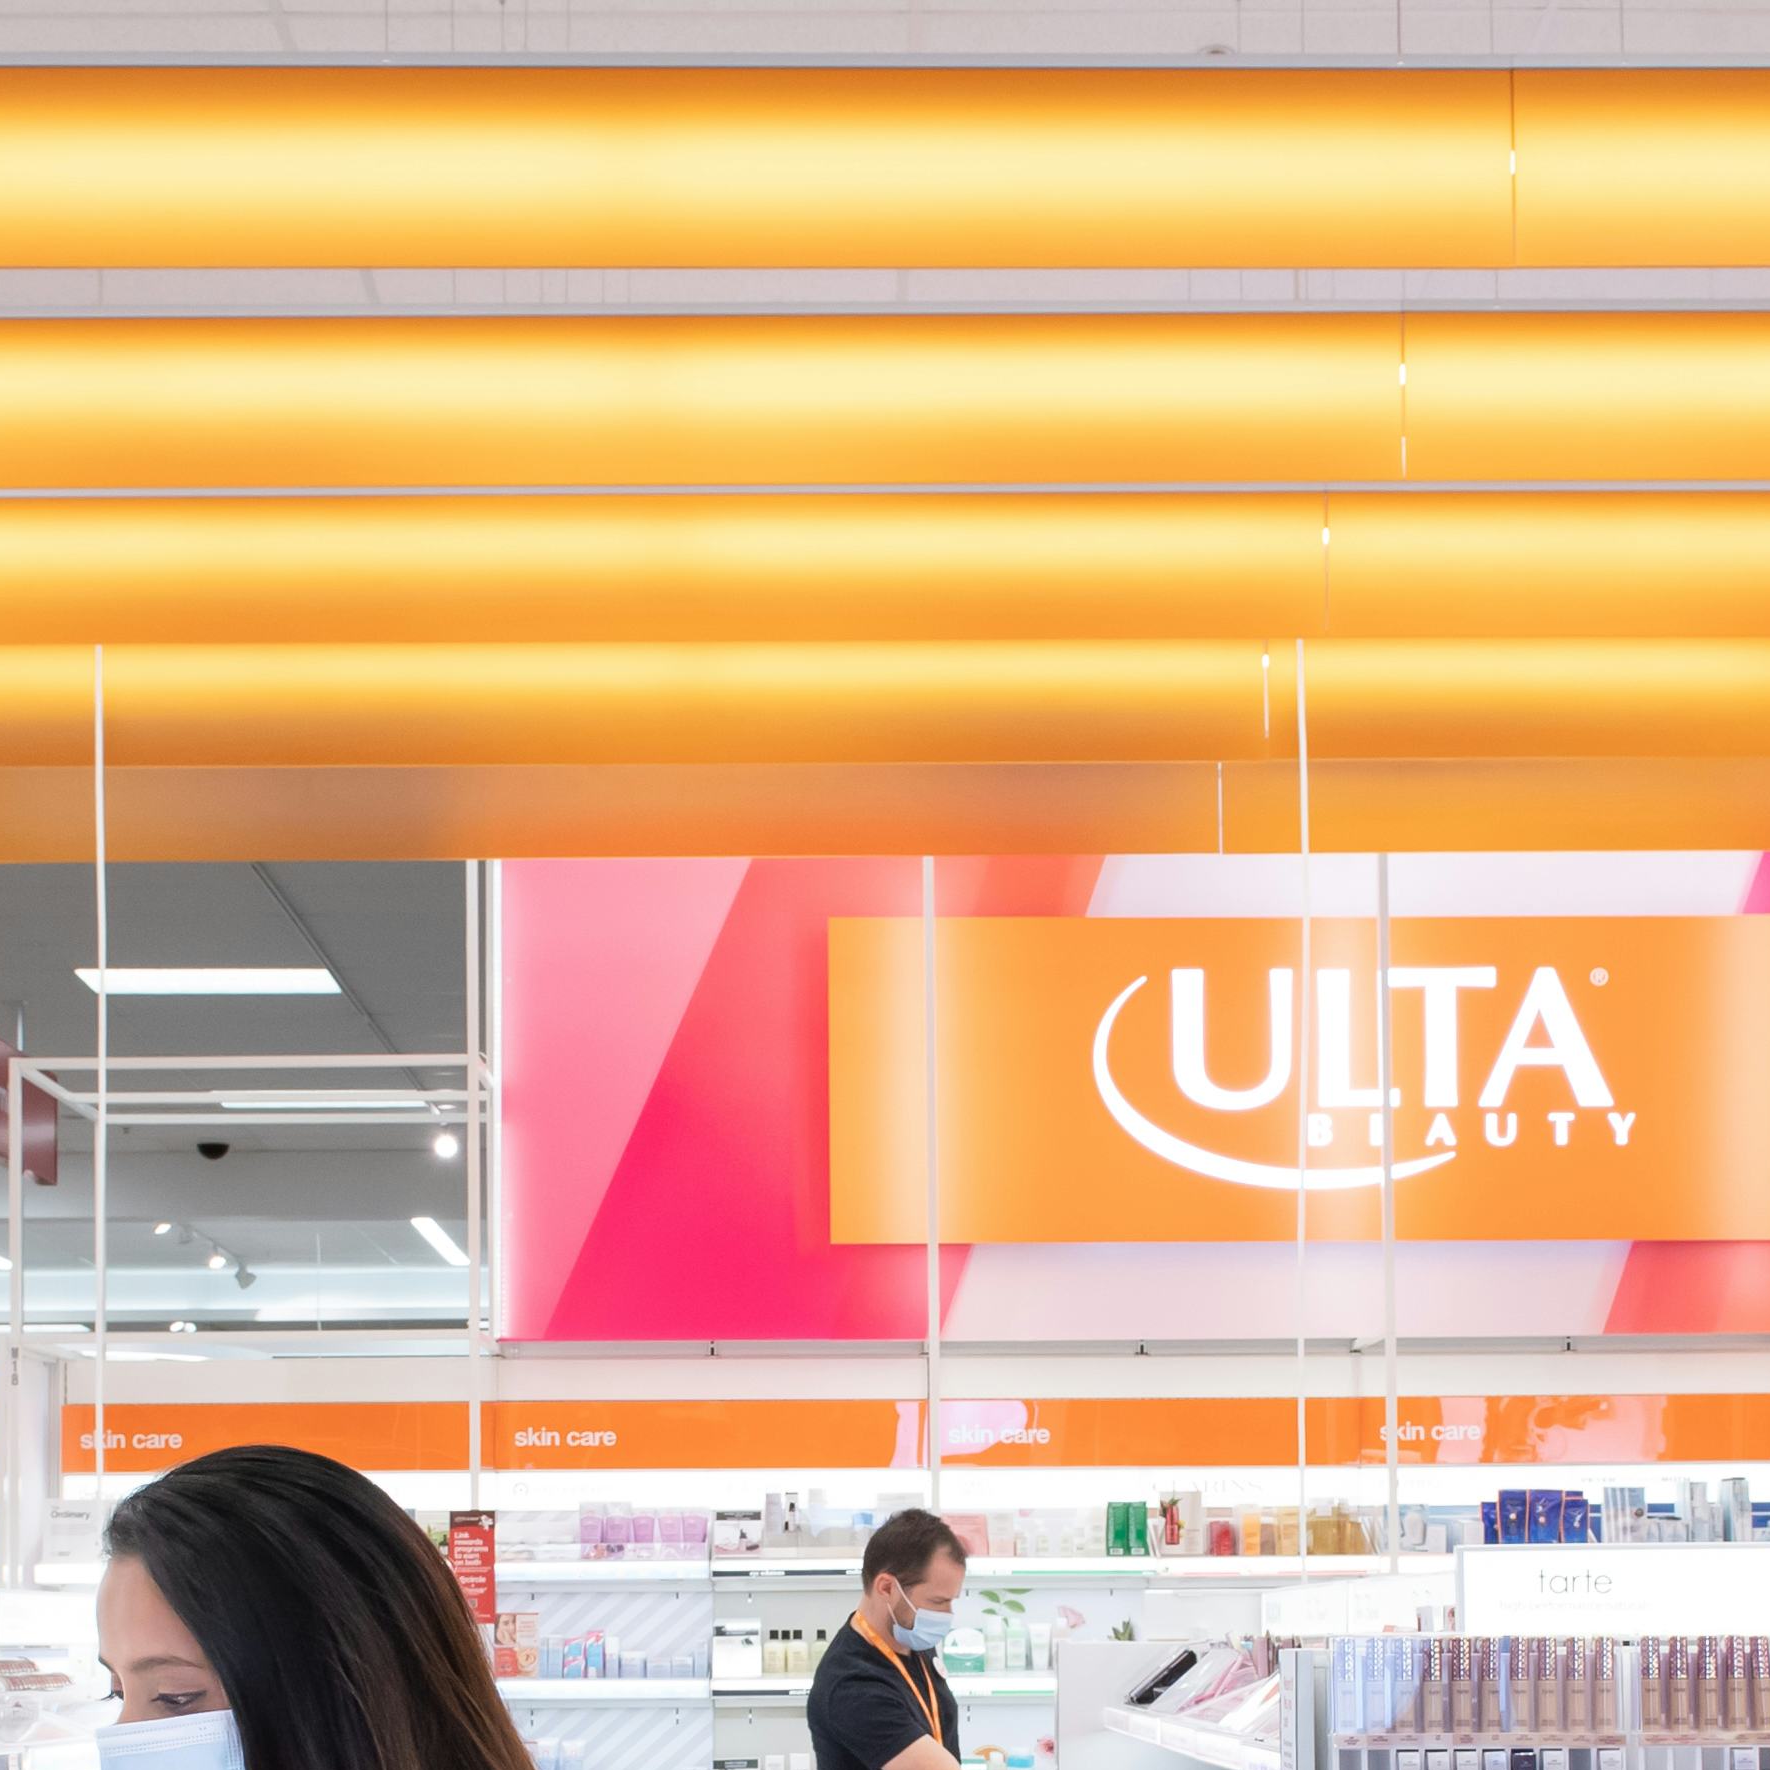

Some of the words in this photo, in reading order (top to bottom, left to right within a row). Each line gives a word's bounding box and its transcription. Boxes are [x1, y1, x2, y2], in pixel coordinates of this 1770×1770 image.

[1171, 966, 1614, 1111] ULTA
[132, 1433, 182, 1449] care
[515, 1428, 560, 1446] skin
[566, 1431, 616, 1447] care
[948, 1426, 994, 1444] skin
[1000, 1428, 1049, 1444] care
[1431, 1424, 1481, 1440] care
[1539, 1569, 1613, 1593] tarte
